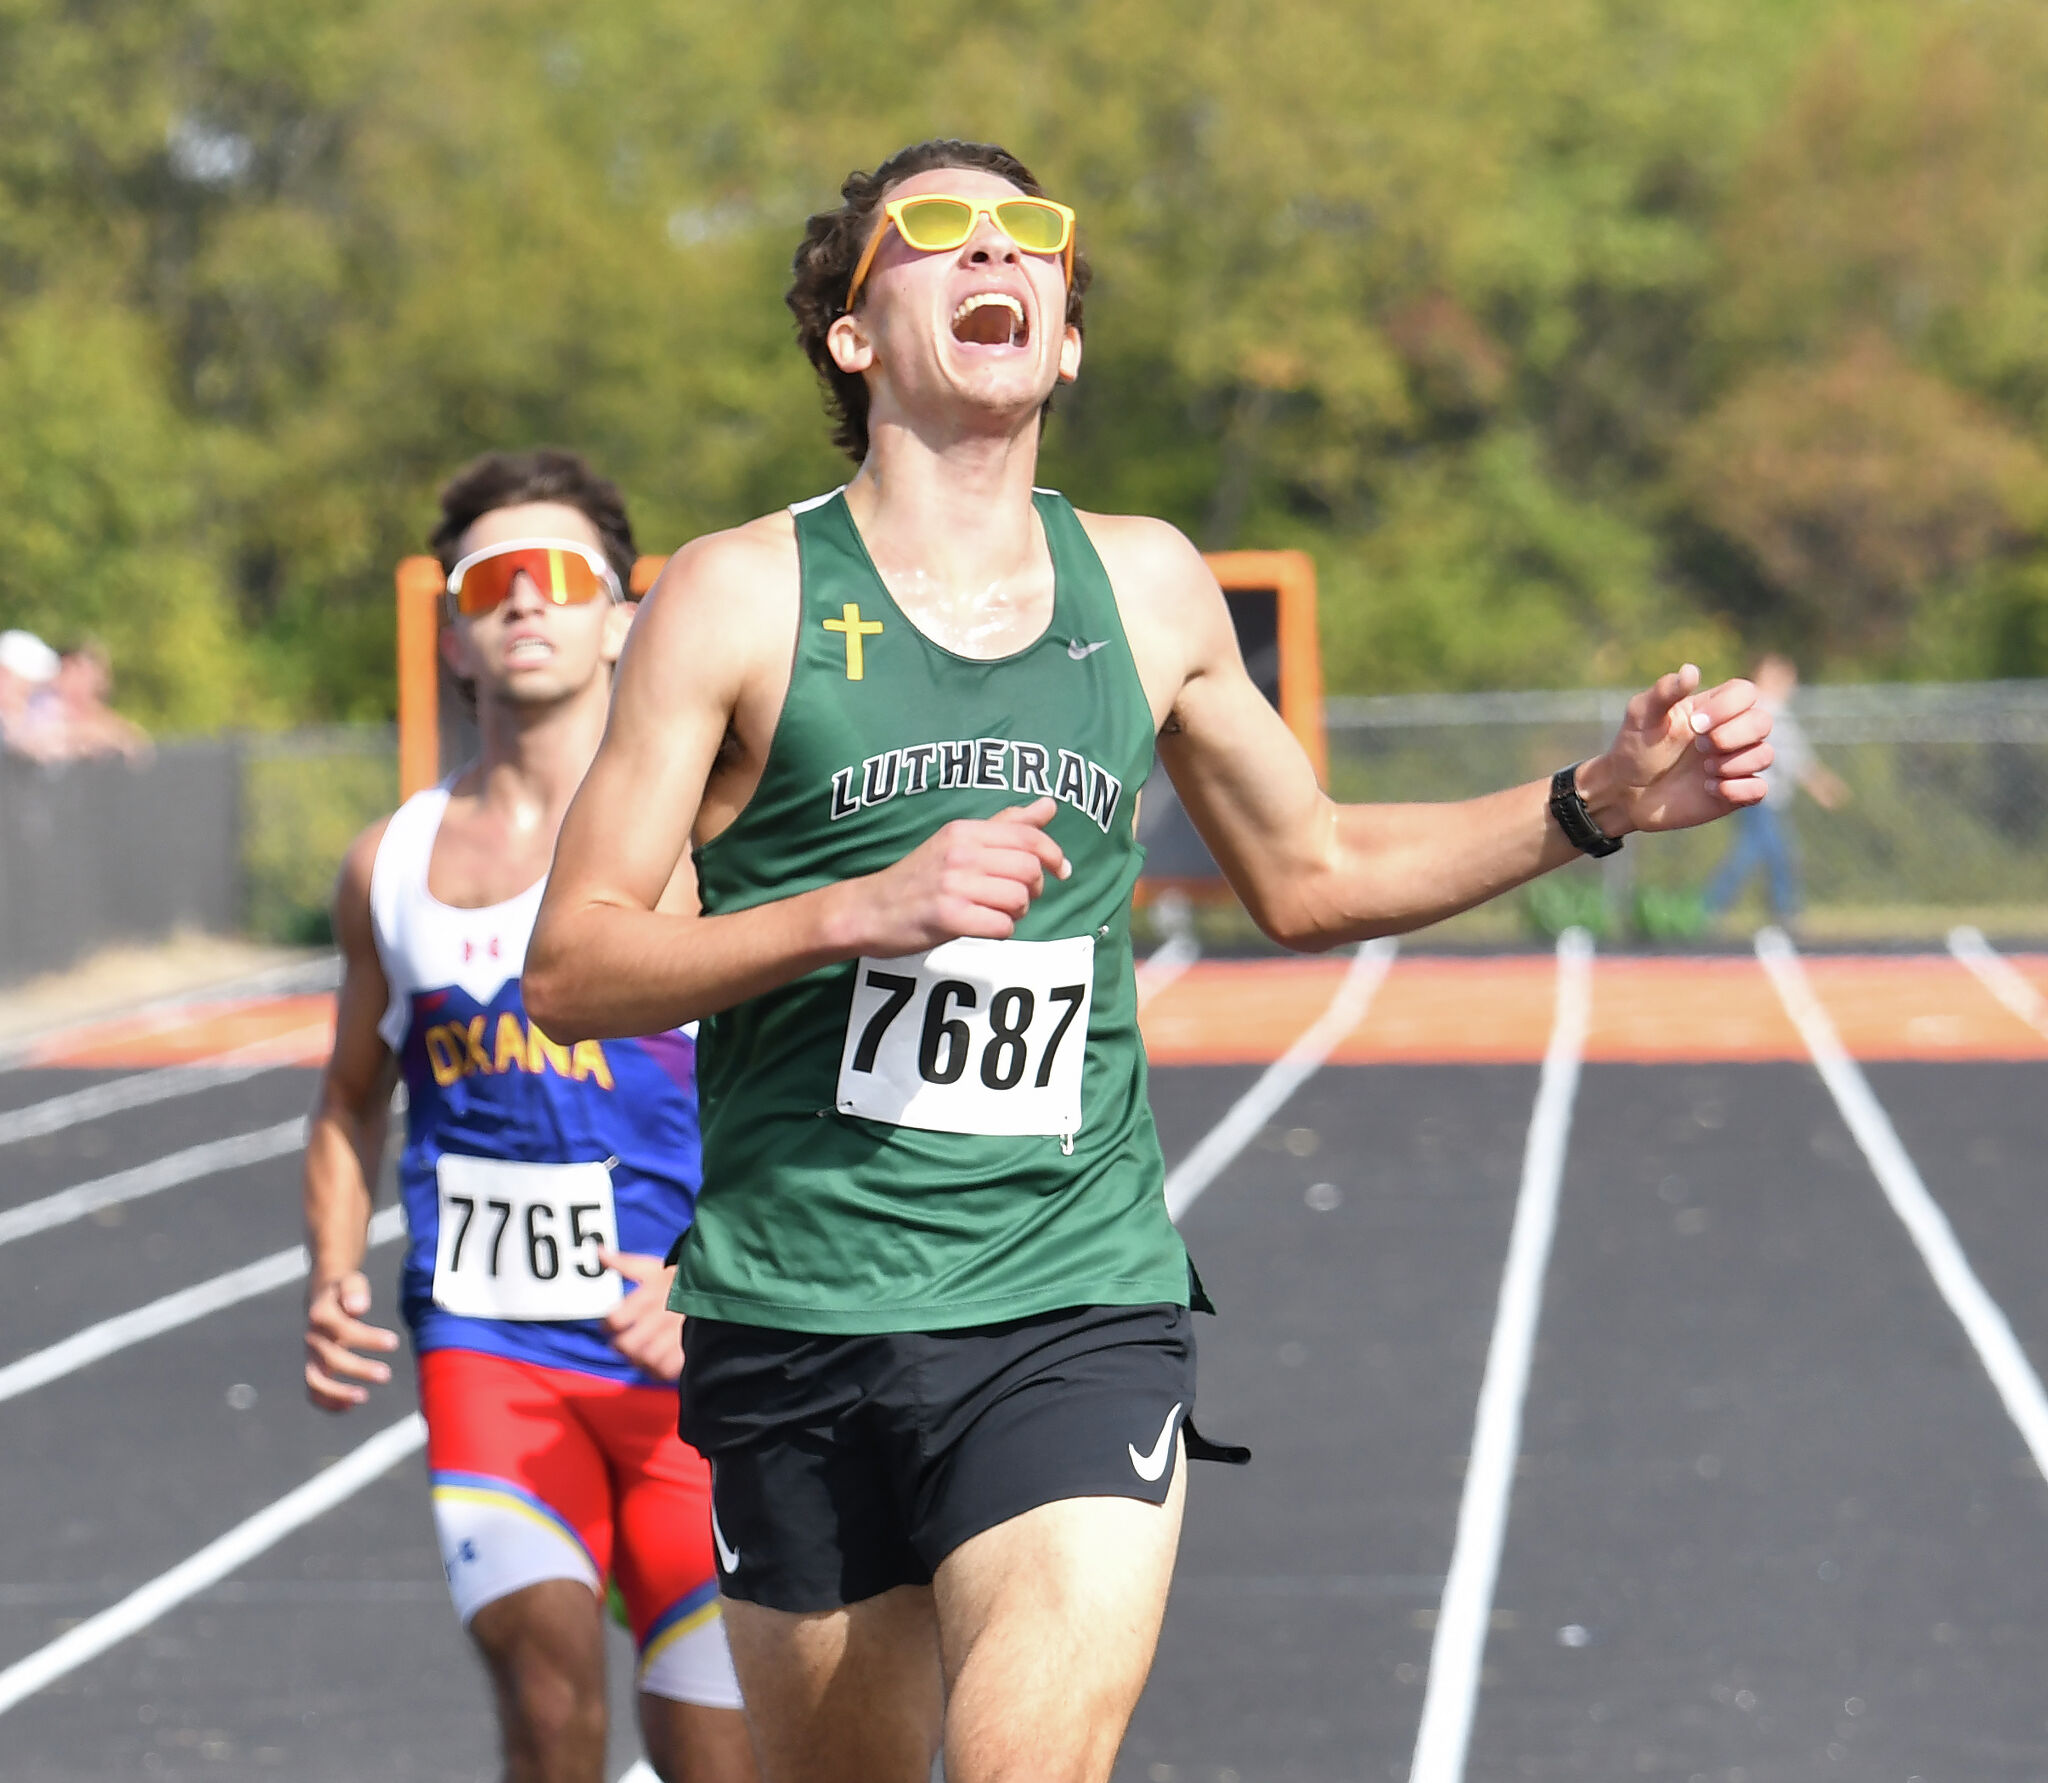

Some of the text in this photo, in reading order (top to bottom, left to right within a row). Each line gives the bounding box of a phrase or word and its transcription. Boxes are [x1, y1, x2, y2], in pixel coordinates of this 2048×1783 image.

[830, 738, 1122, 834] LUTHERAN
[851, 969, 1086, 1091] 7687
[449, 1196, 607, 1280] 7765
